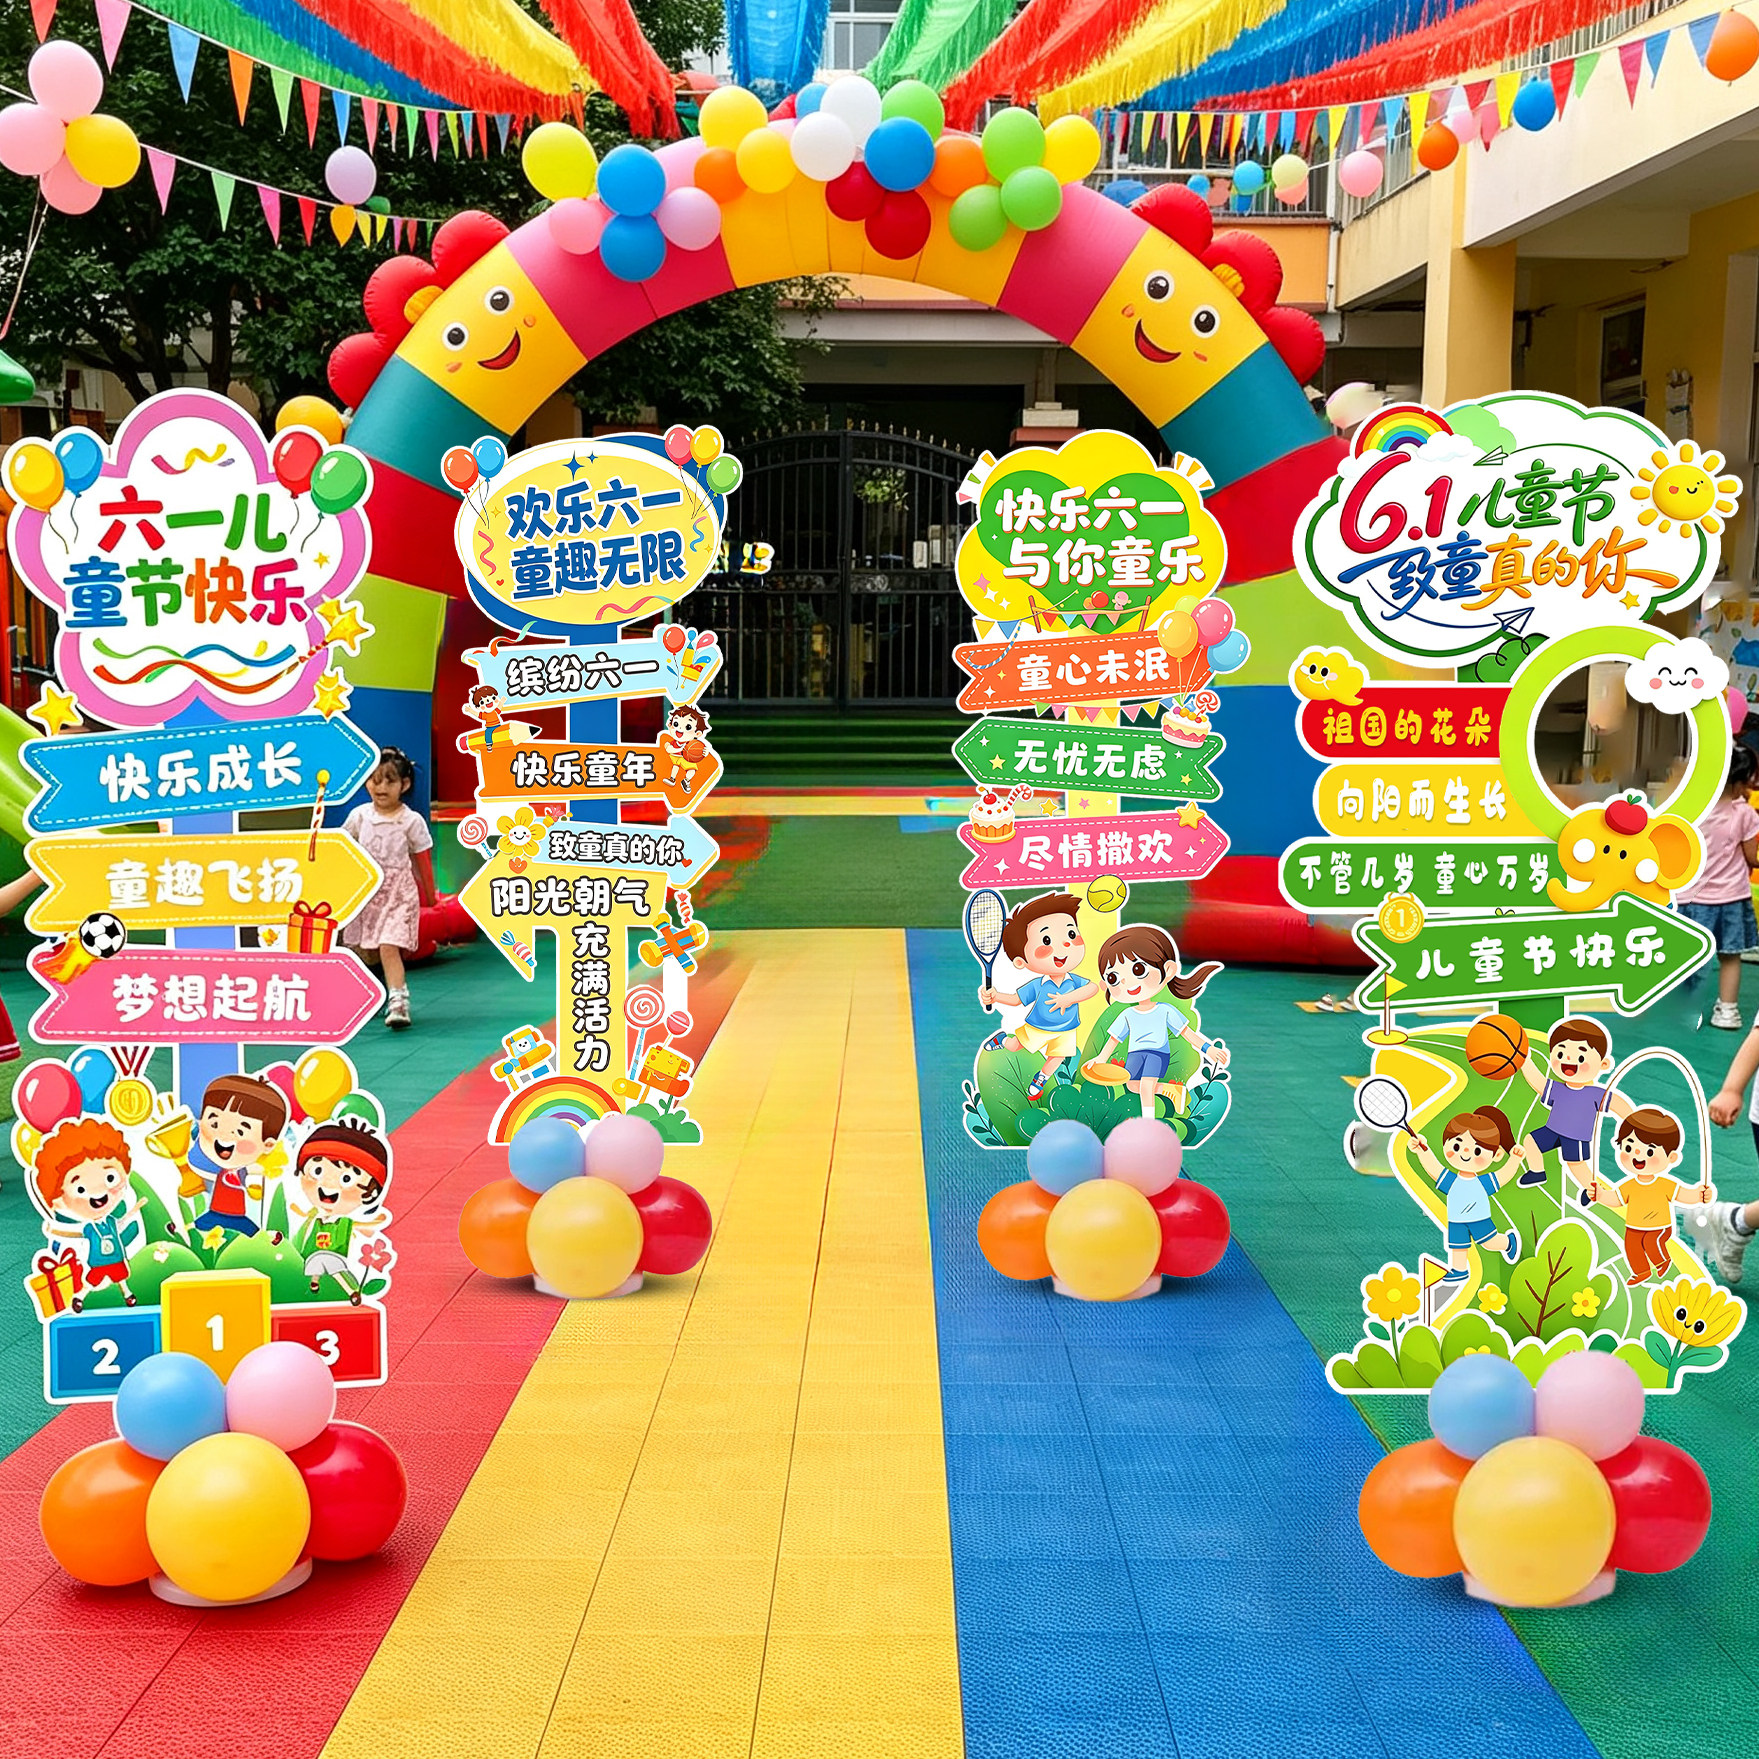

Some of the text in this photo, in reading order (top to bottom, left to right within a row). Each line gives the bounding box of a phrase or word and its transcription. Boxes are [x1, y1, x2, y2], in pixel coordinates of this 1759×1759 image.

[98, 485, 288, 553] 六一儿
[506, 479, 681, 539] 欢乐六一
[995, 486, 1185, 534] 快乐六一
[511, 531, 686, 599] 童趣无限
[1002, 535, 1206, 588] 与你童乐
[1338, 525, 1680, 621] 致童真的你
[63, 556, 309, 628] 童节快乐
[505, 651, 660, 698] 缤纷六一
[1016, 646, 1171, 692] 童心未泯
[1322, 706, 1492, 747] 祖国的花朵
[99, 741, 302, 803] 快乐成长
[511, 750, 656, 788] 快乐童年
[1013, 739, 1168, 781] 无忧无虑
[1337, 776, 1508, 825] 向阳而生长
[549, 830, 685, 867] 致童真的你
[1018, 829, 1174, 872] 尽情撒欢
[105, 857, 304, 910] 童趣飞扬
[490, 876, 651, 917] 阳光朝气
[1299, 851, 1549, 895] 不管几岁 童心万岁
[1416, 926, 1667, 984] 儿童节快乐
[112, 973, 312, 1023] 梦想起航
[571, 920, 612, 1073] 充满活力
[91, 1338, 121, 1375] 2
[206, 1314, 224, 1352] 1
[316, 1330, 340, 1366] 3
